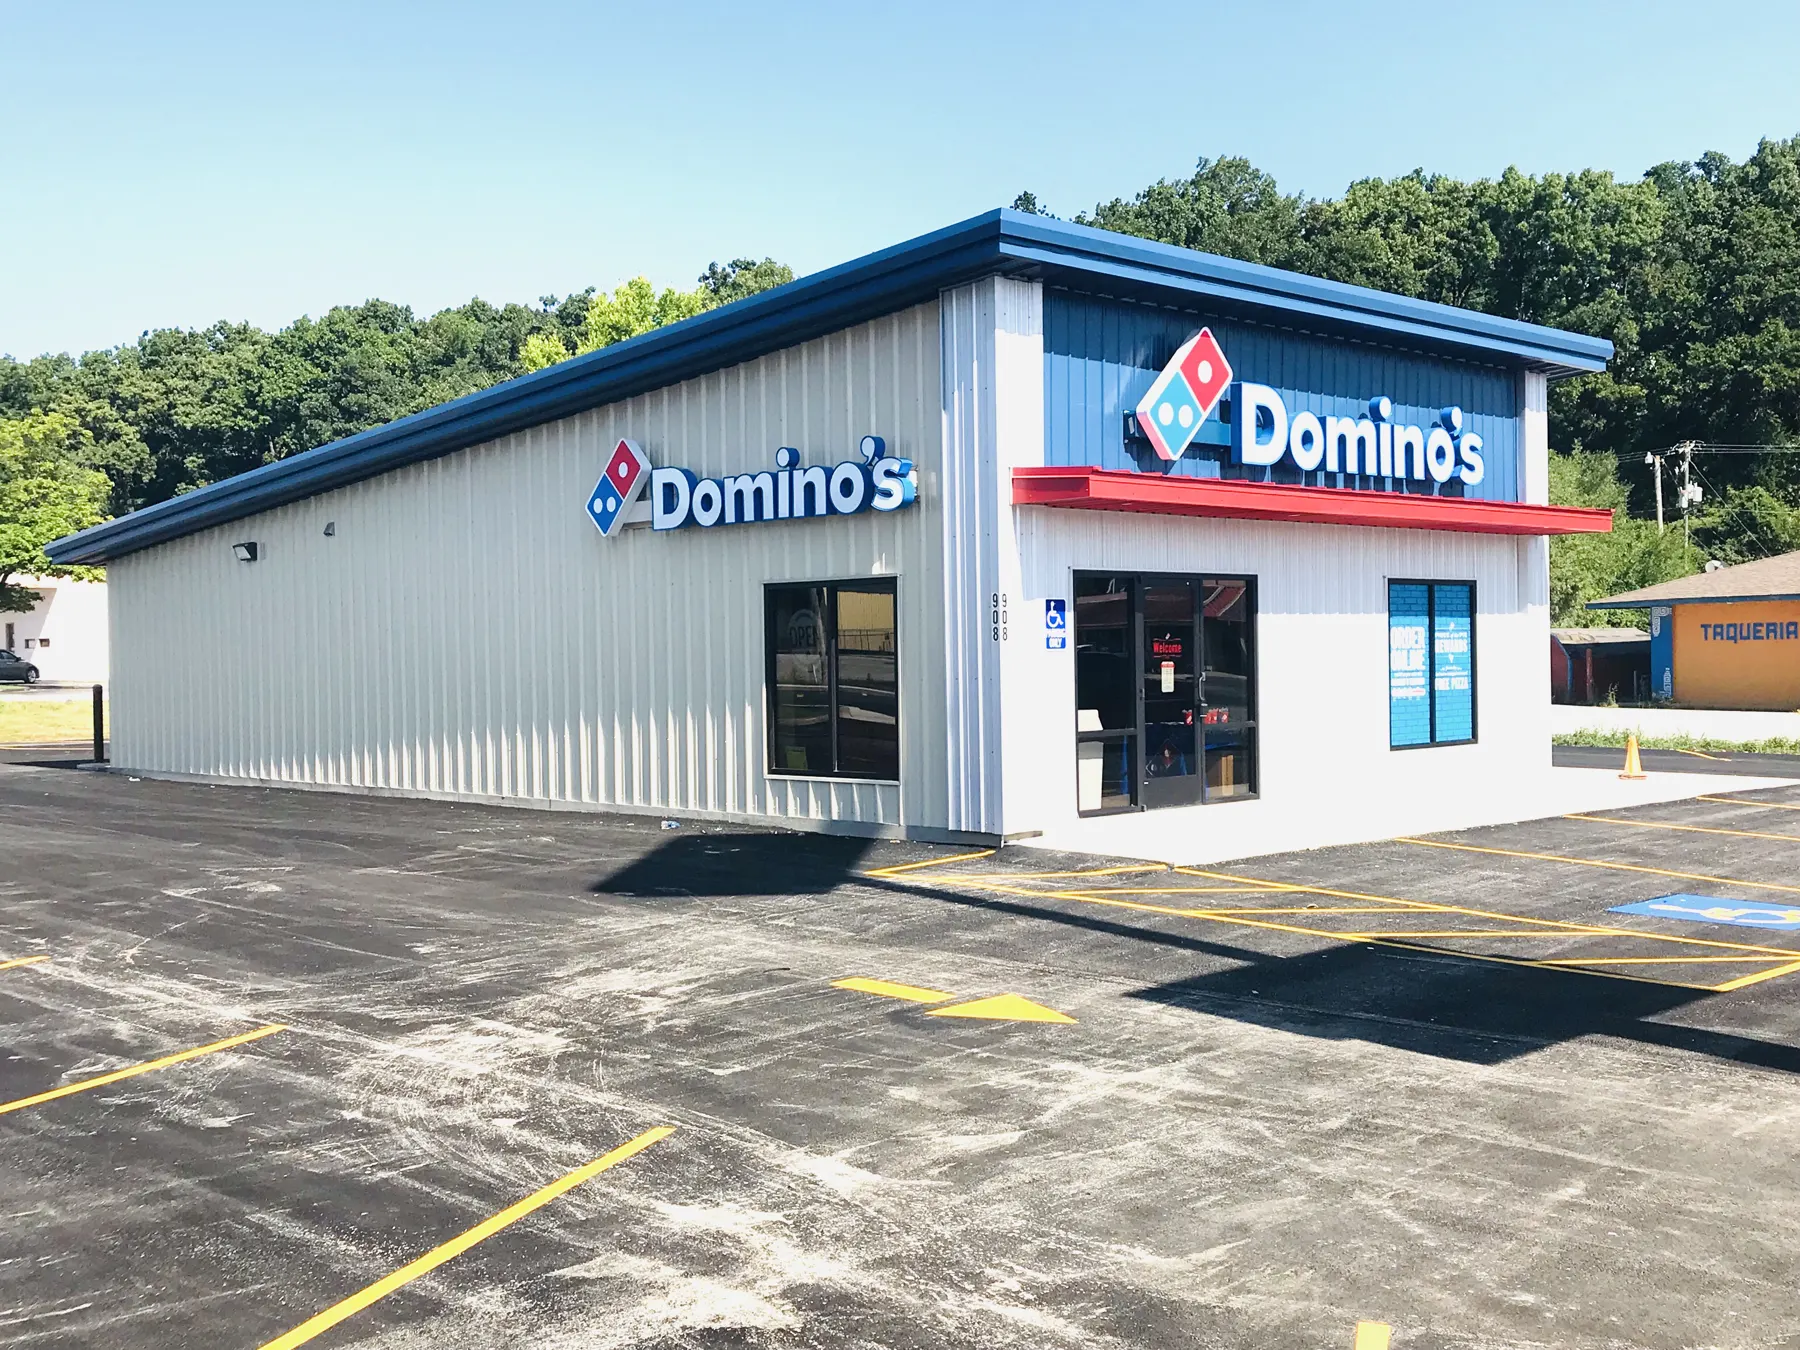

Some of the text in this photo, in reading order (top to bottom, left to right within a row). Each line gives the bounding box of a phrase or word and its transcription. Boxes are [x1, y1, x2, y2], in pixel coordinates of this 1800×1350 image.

[1239, 381, 1485, 486] Domino's
[652, 436, 912, 531] Domino's
[1153, 642, 1182, 653] Welcome
[1700, 621, 1799, 644] TAQUERIA
